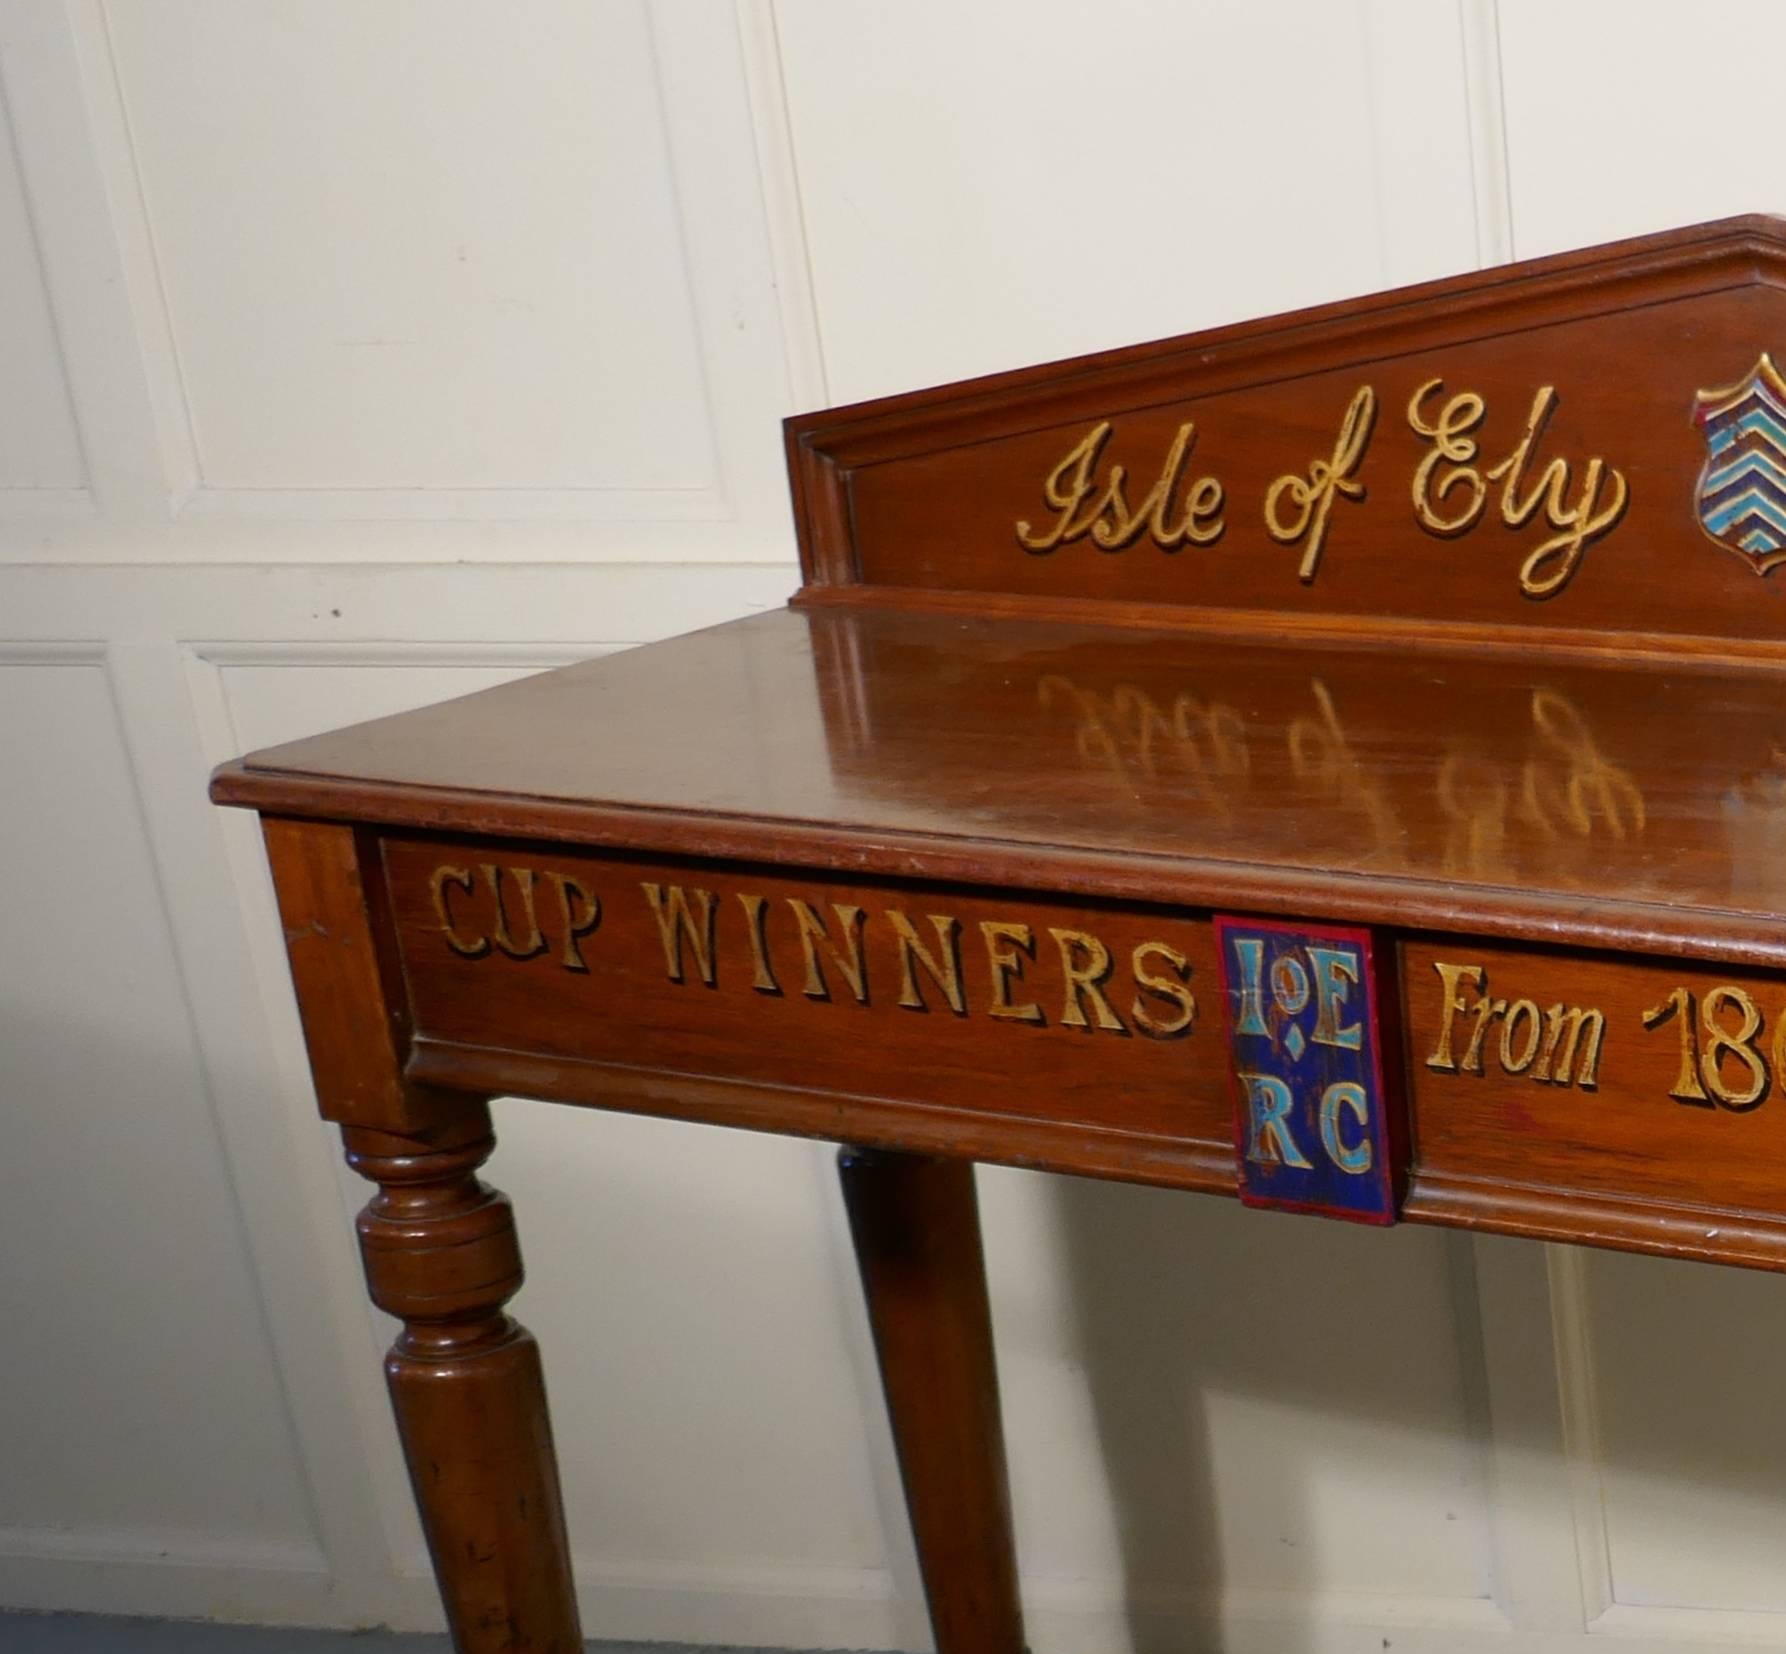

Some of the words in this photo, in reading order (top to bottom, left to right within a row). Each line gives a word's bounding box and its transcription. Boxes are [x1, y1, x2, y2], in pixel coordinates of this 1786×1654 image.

[1017, 422, 1225, 551] Isle
[1263, 385, 1375, 581] of
[1407, 378, 1628, 597] Ely
[428, 862, 601, 972] CUP
[639, 881, 1196, 1034] WINNERS
[1425, 962, 1607, 1088] From
[1237, 1072, 1373, 1175] RC
